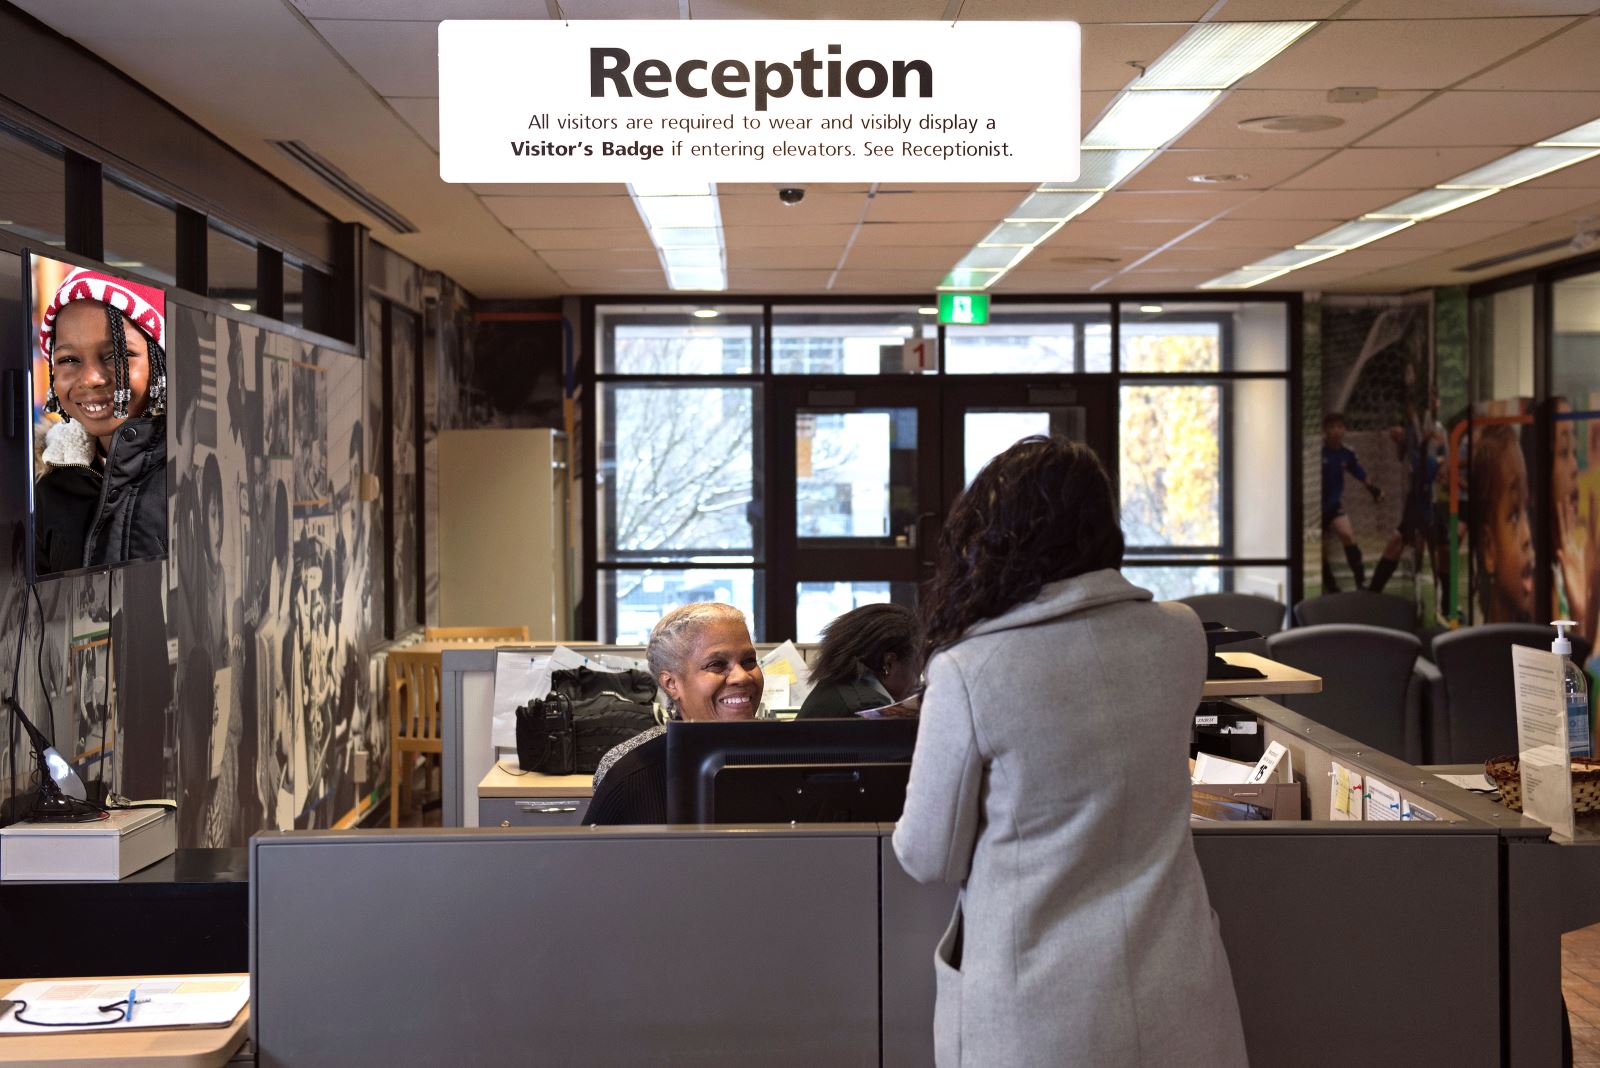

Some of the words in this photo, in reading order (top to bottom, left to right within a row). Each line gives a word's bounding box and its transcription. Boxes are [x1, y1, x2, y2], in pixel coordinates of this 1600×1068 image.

[590, 44, 932, 111] Reception
[528, 114, 548, 129] All
[558, 114, 617, 129] visitors
[626, 118, 653, 129] are
[662, 114, 733, 133] required
[743, 116, 760, 129] to
[769, 118, 812, 129] wear
[821, 114, 852, 129] and
[861, 114, 911, 133] visibly
[919, 114, 978, 133] display
[986, 118, 996, 129] a
[511, 141, 593, 157] Visitor's
[603, 141, 663, 161] Badge
[672, 141, 683, 156] if
[691, 141, 764, 160] entering
[773, 141, 856, 156] elevators.
[864, 142, 893, 156] See
[903, 141, 1013, 160] Receptionist.
[913, 343, 925, 368] 1
